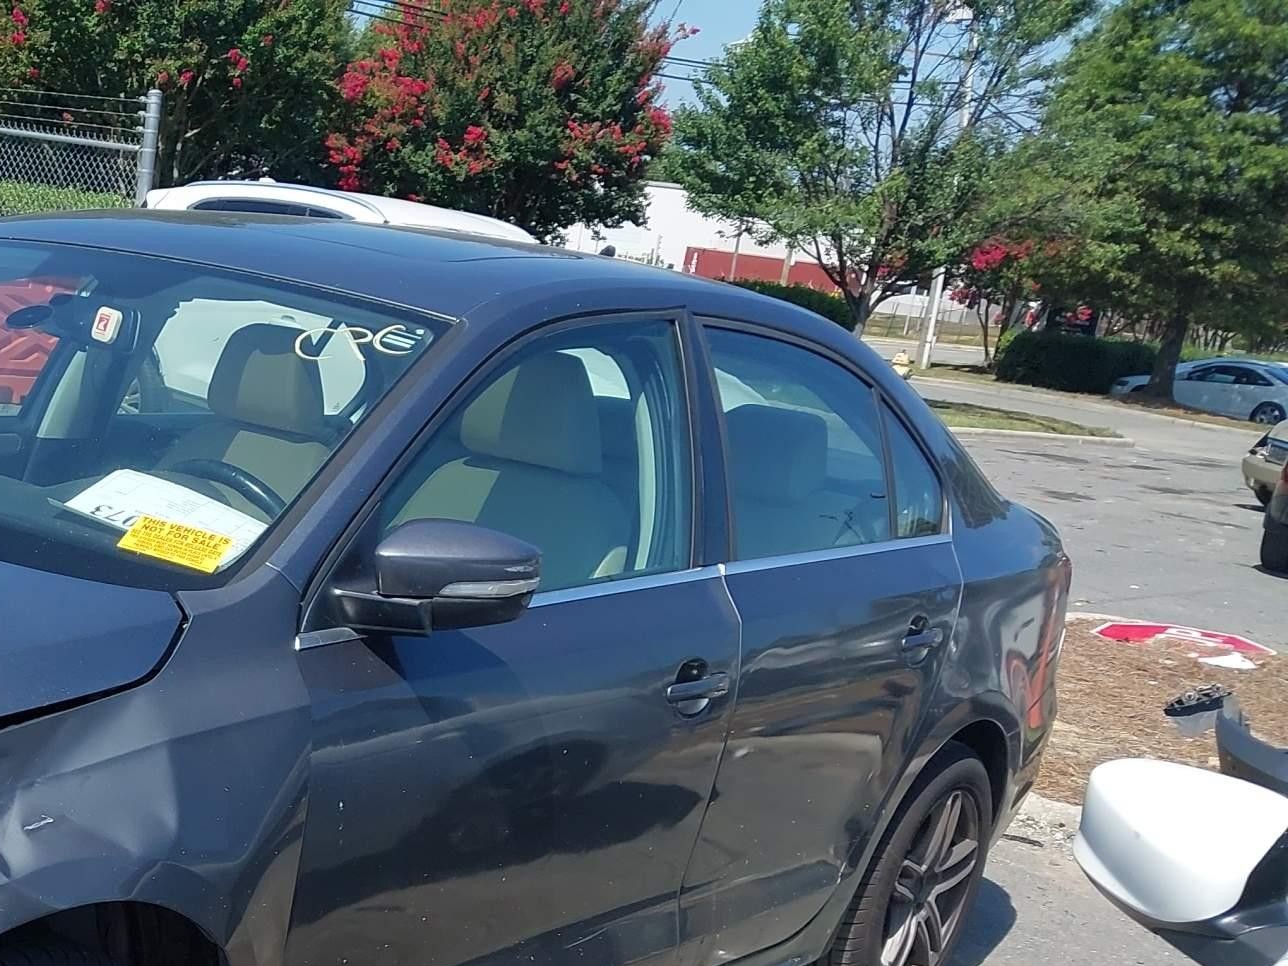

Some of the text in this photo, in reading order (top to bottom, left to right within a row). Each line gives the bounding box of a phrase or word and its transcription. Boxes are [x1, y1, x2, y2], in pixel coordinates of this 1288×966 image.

[141, 516, 231, 544] THIS VEHICLE IS
[141, 523, 165, 534] NOT
[165, 530, 189, 541] FOR
[191, 537, 221, 550] SALE
